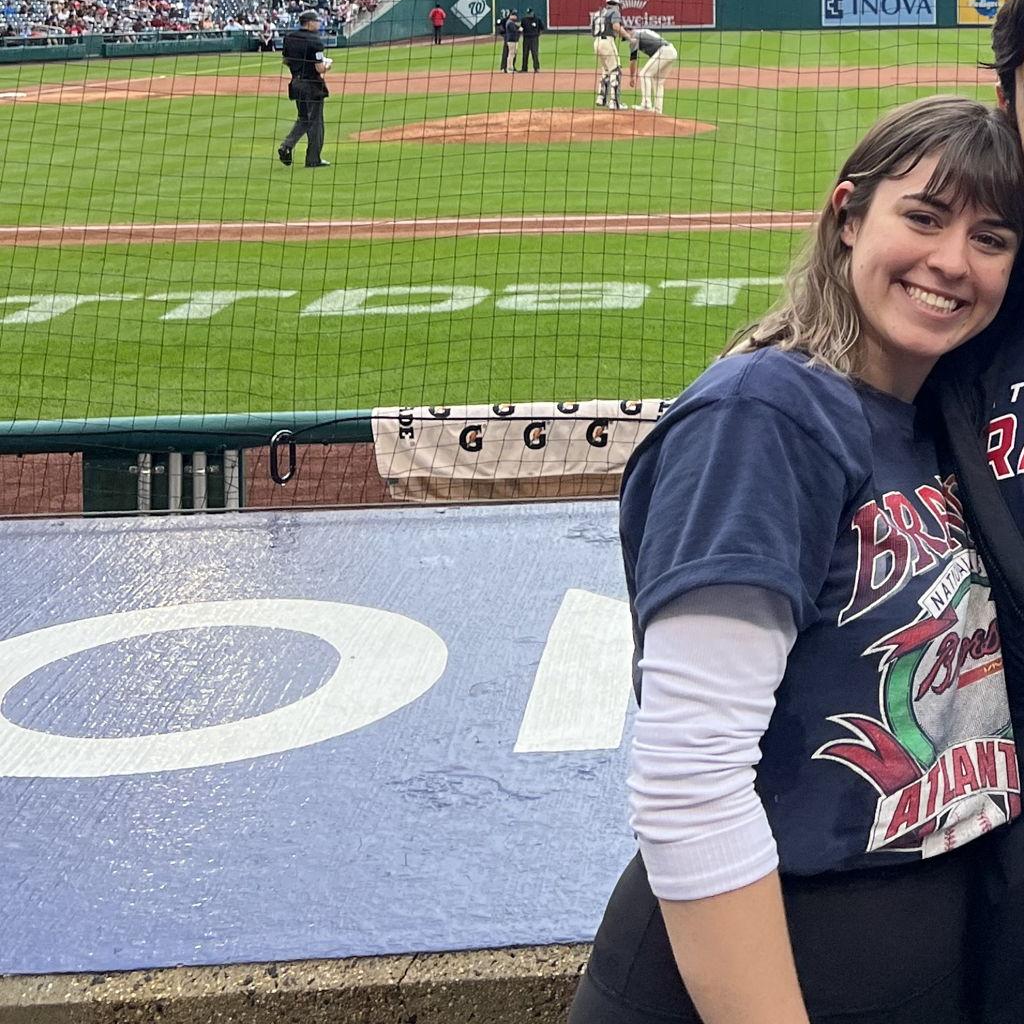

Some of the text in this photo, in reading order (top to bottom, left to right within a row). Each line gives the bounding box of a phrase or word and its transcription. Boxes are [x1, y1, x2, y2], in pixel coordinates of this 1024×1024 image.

[459, 424, 483, 453] G
[523, 422, 548, 450] G
[884, 741, 1020, 841] ATLANT
